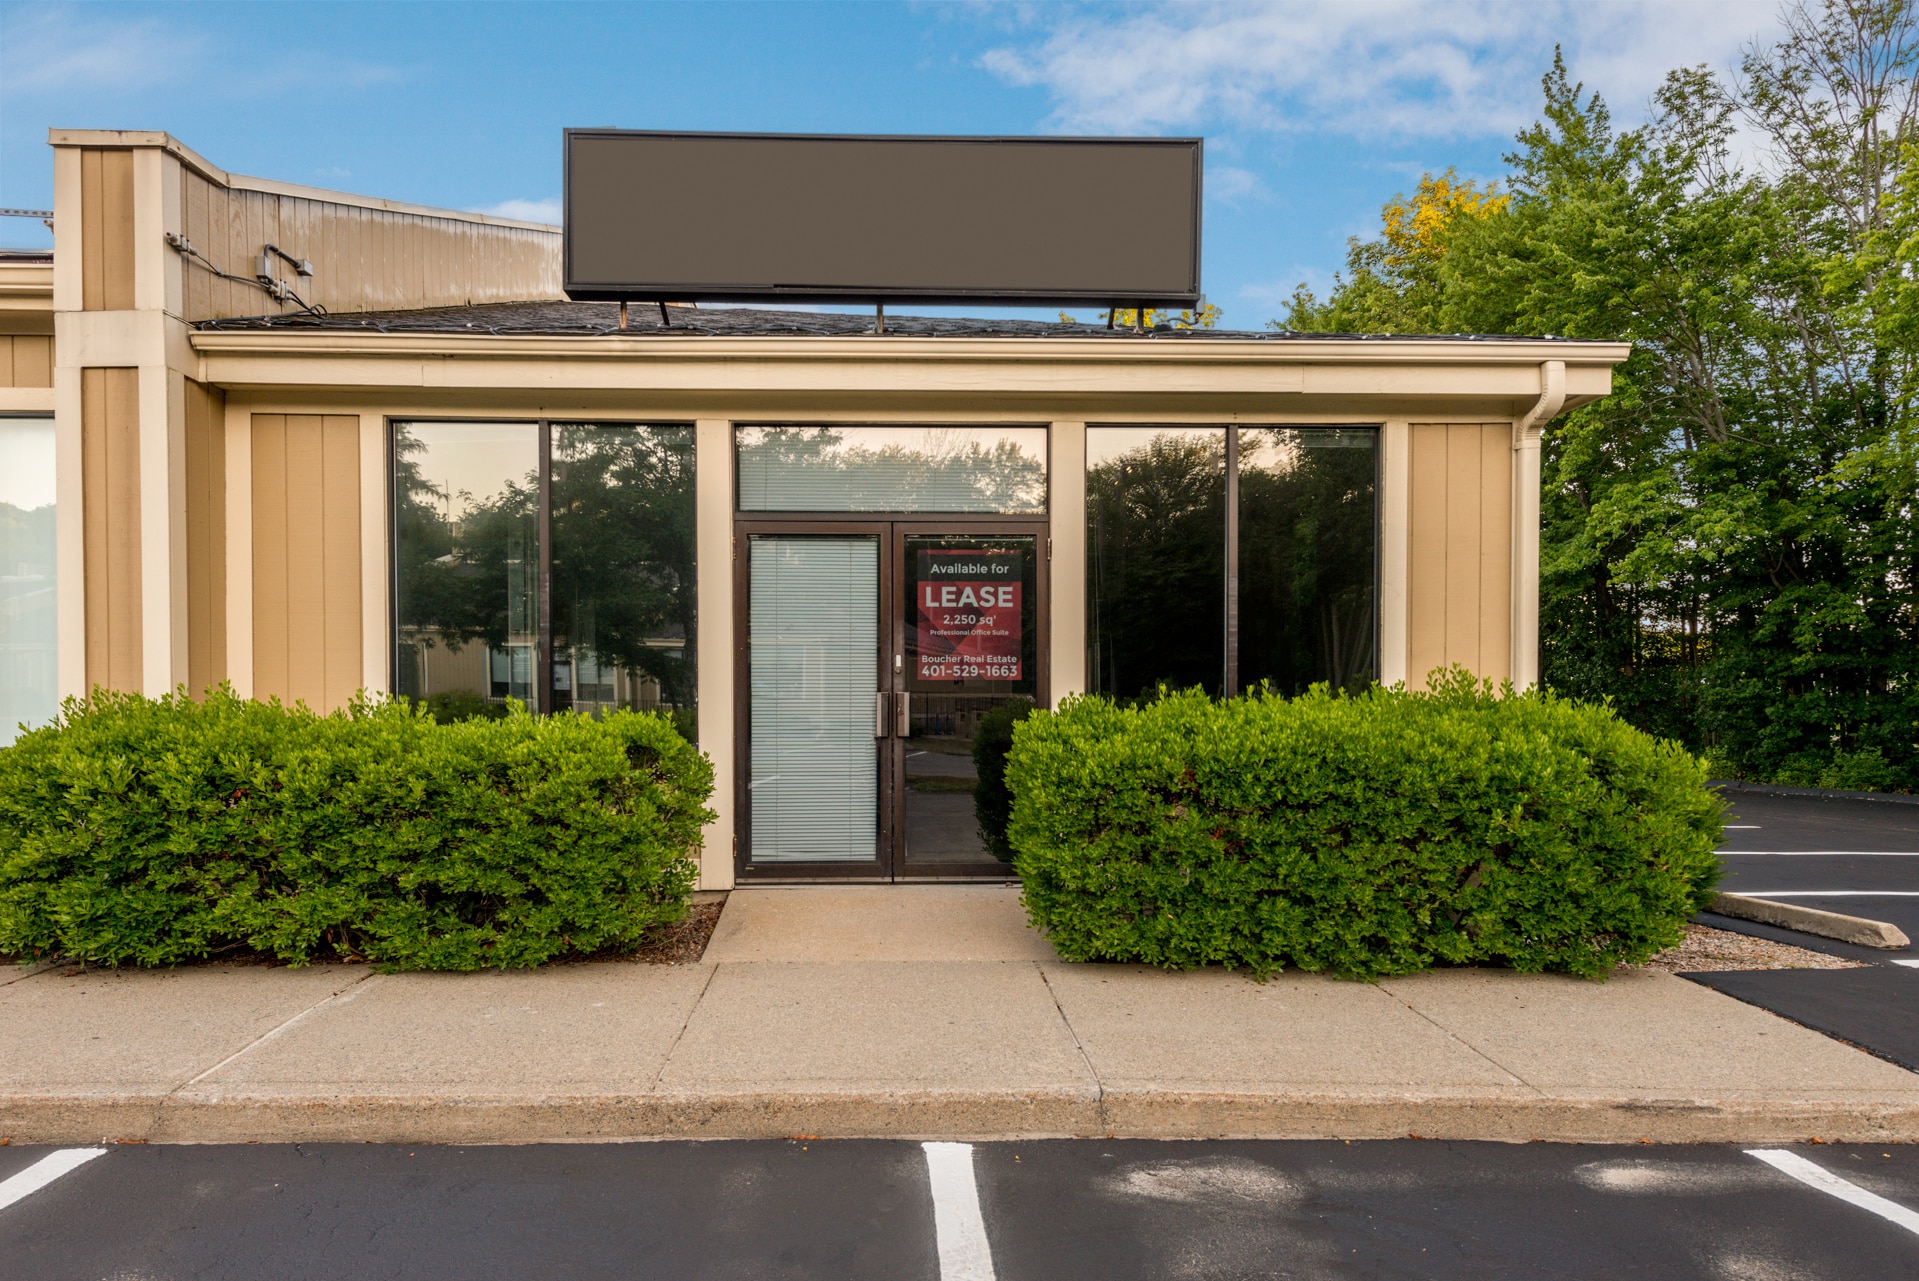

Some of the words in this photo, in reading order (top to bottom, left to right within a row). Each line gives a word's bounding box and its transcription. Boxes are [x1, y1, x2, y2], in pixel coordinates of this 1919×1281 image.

[930, 563, 988, 574] Available
[991, 563, 1009, 574] for
[925, 586, 1014, 608] LEASE
[943, 614, 976, 626] 2,250
[921, 655, 961, 663] Boucher
[963, 655, 984, 663] Real
[986, 655, 1018, 663] Estate
[921, 665, 1018, 677] 401-529-1663
